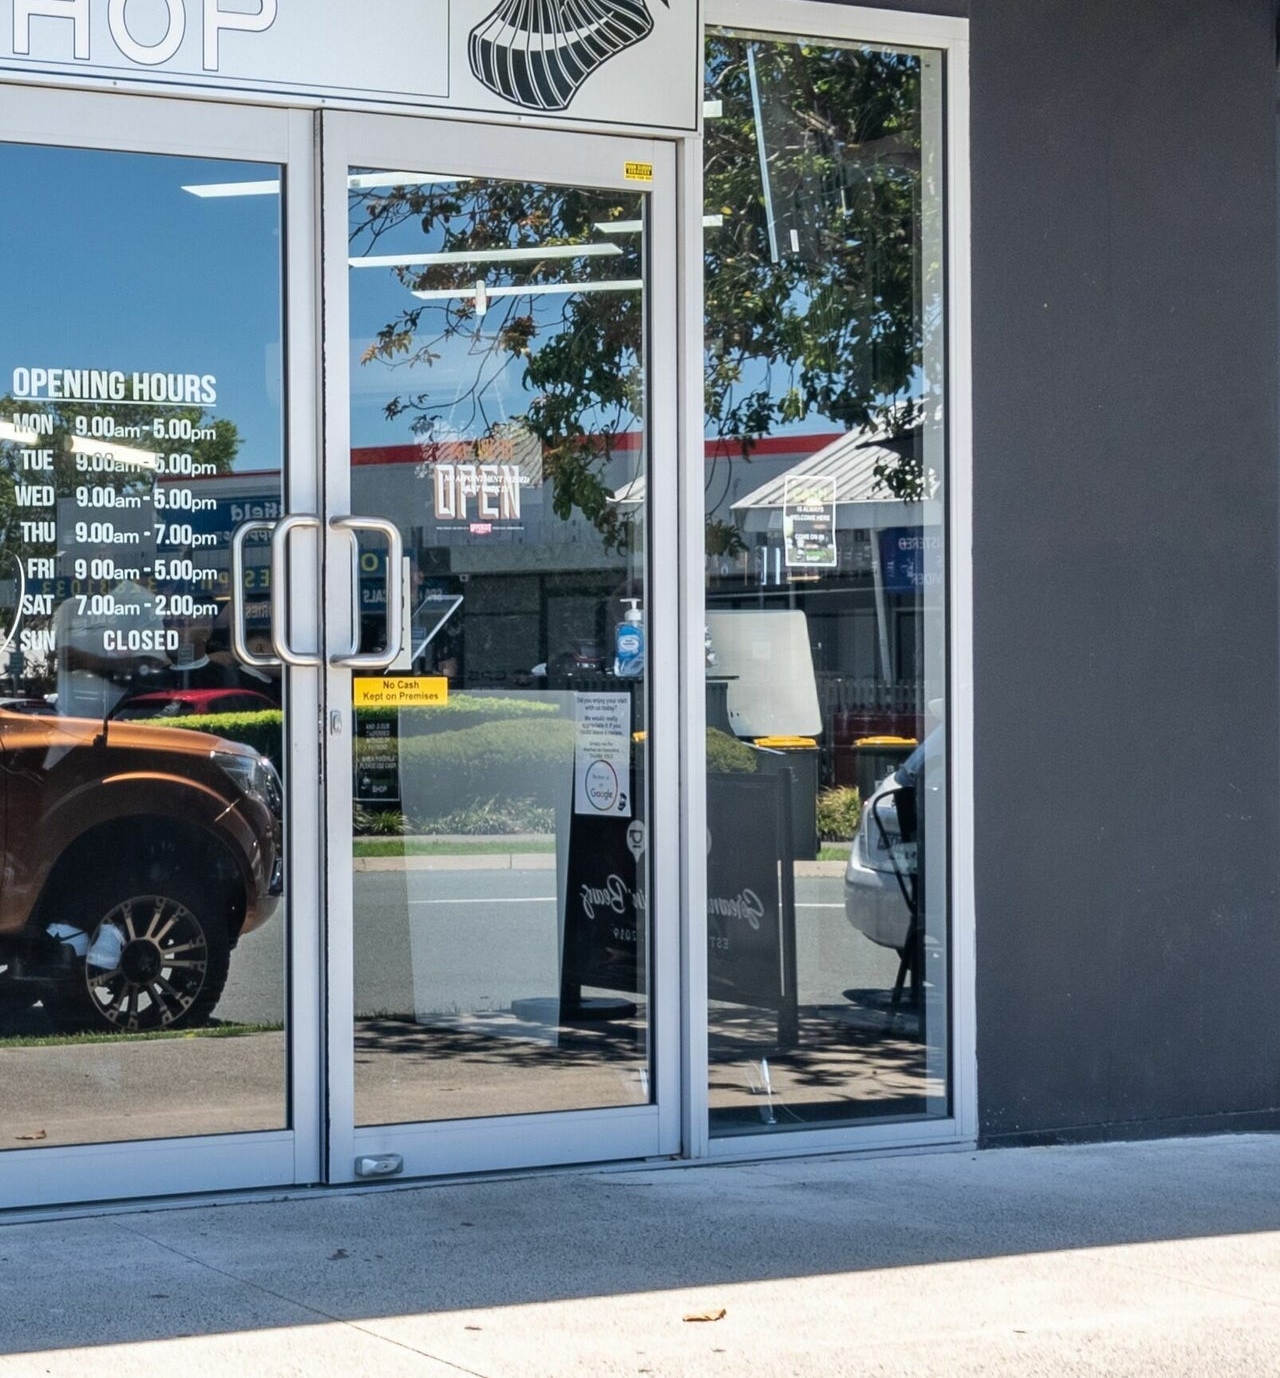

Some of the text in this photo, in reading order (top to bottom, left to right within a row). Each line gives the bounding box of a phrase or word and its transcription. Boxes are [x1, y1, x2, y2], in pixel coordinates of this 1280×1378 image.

[13, 367, 217, 403] OPENING HOURS
[13, 413, 54, 435] MON
[75, 416, 141, 438] 9.00am
[153, 419, 217, 442] 5.00pm
[20, 449, 54, 470] TUE
[75, 452, 141, 472] 9.00am
[153, 453, 217, 477] 5.00pm
[14, 486, 55, 506] WED
[76, 488, 141, 509] 9.00am
[153, 488, 217, 512] 5.00pm
[434, 464, 521, 520] OPEN
[20, 522, 55, 543] THU
[75, 524, 140, 544] 9.00am
[154, 524, 217, 548] 7.00pm
[27, 559, 55, 580] FRI
[154, 560, 218, 584] 5.00pm
[22, 594, 55, 616] SAT
[75, 595, 140, 616] 7.00am
[154, 595, 218, 620] 2.00pm
[20, 630, 179, 651] SUN CLOSED
[363, 692, 383, 701] Kept
[399, 692, 439, 700] Premises
[382, 680, 419, 689] No Cash
[590, 787, 613, 800] Google
